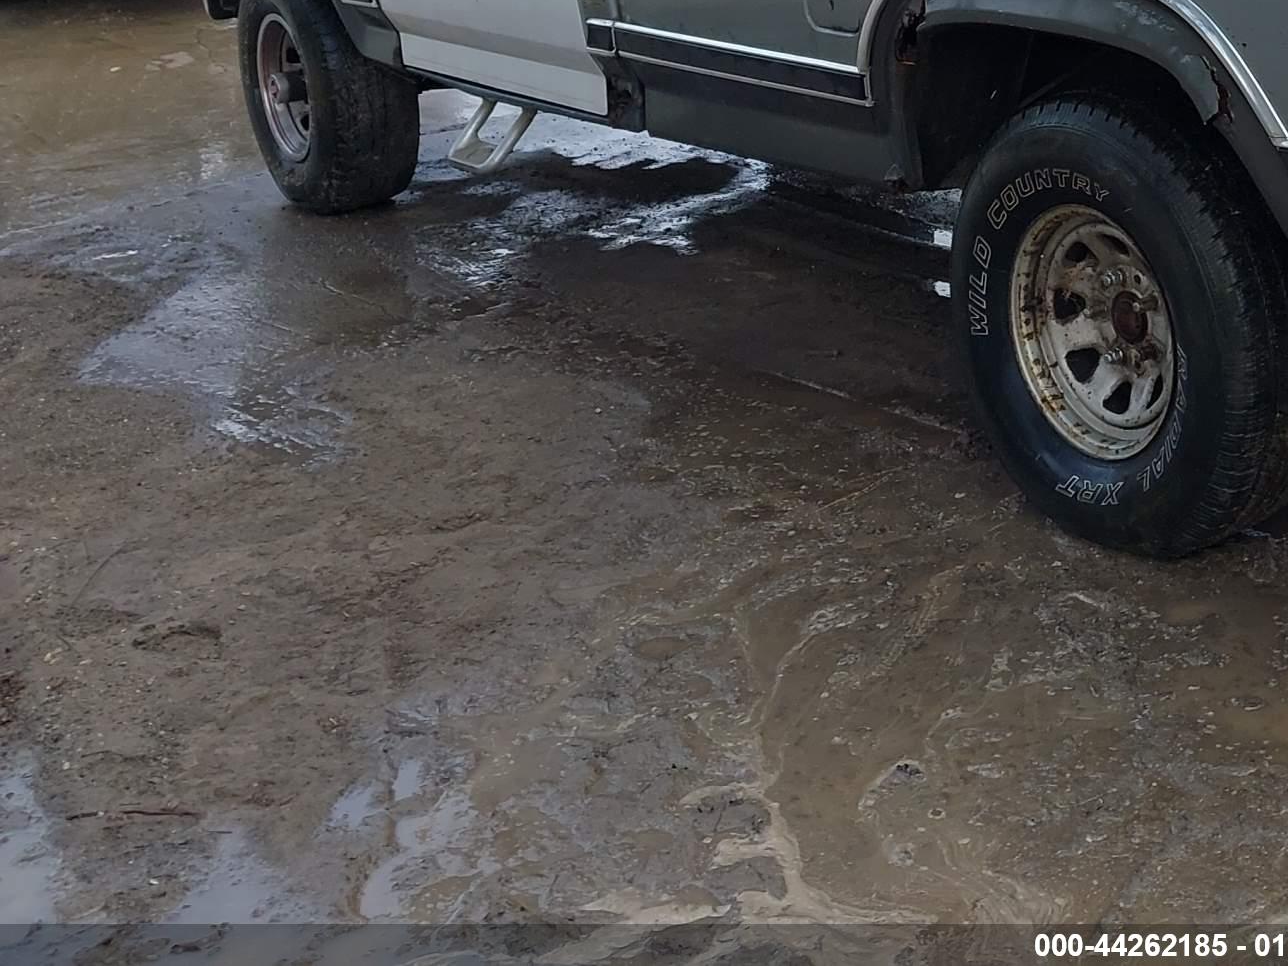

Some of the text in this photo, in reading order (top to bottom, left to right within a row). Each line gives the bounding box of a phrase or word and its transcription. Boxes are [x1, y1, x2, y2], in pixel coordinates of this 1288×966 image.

[968, 168, 1188, 506] WILD COUNTRY RADIAL XRT
